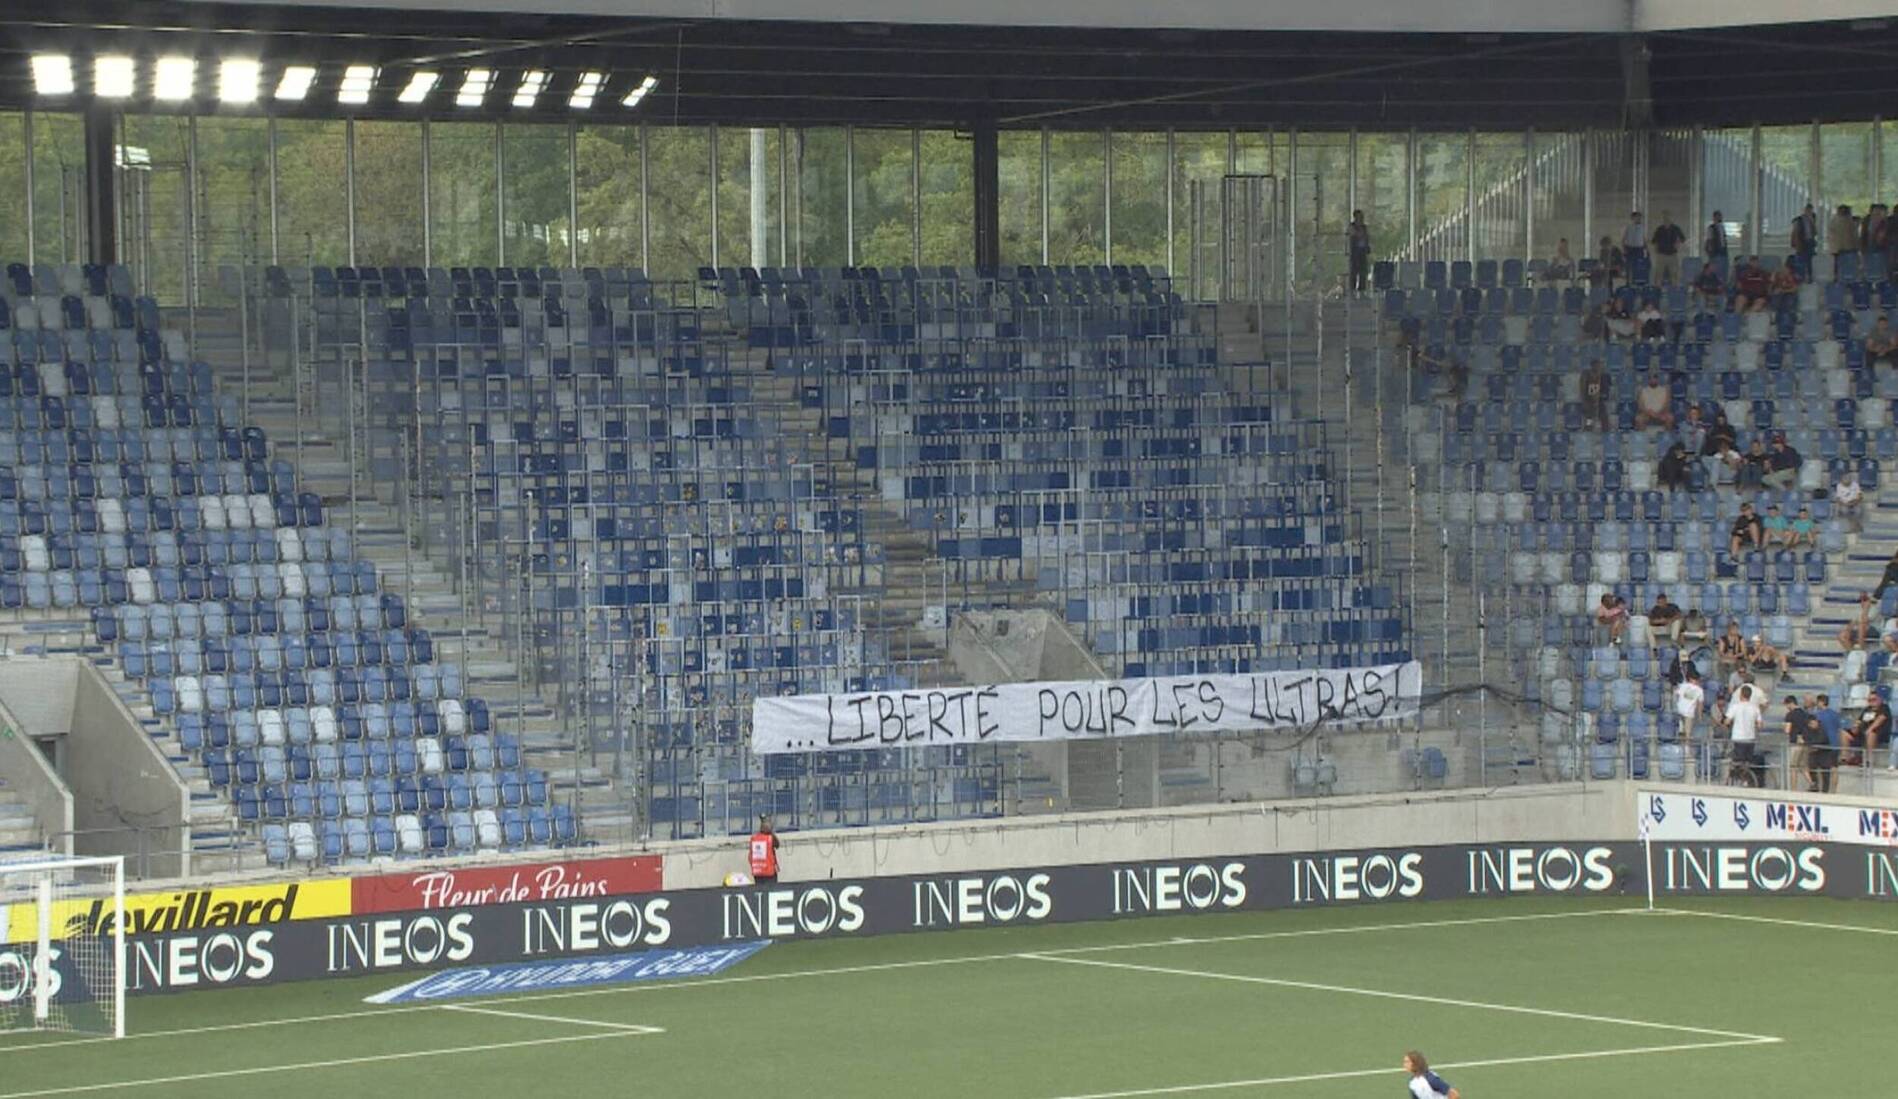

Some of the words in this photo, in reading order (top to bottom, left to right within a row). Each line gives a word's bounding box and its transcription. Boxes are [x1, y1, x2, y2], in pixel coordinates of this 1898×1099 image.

[1038, 687, 1135, 736] POUR
[1152, 679, 1225, 728] LES
[413, 871, 494, 909] Fleur
[500, 872, 530, 903] de
[535, 865, 608, 899] Pains
[1112, 863, 1246, 914] INEOS
[1292, 853, 1424, 902] INEOS
[1468, 847, 1613, 893] INEOS
[1665, 847, 1824, 891] INEOS
[721, 885, 864, 939] INEOS
[912, 874, 1051, 926] INEOS
[327, 914, 474, 971] INEOS
[522, 899, 671, 954] INEOS
